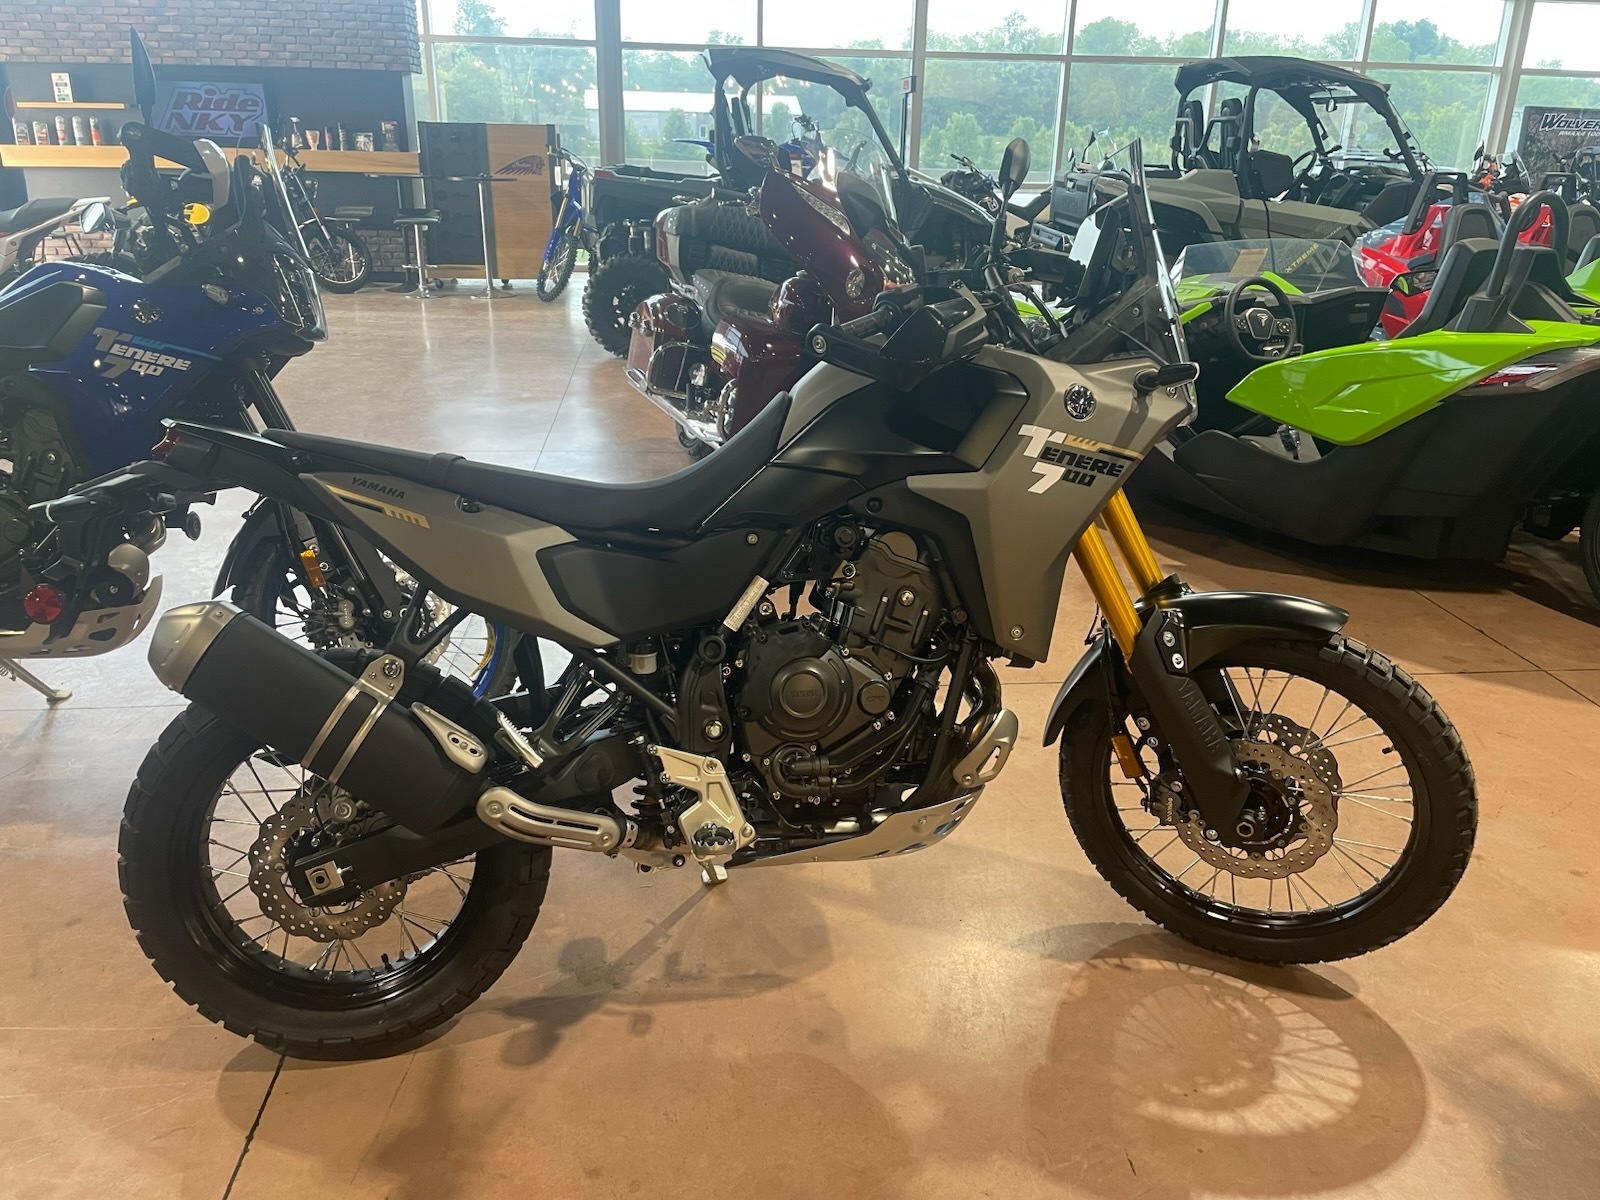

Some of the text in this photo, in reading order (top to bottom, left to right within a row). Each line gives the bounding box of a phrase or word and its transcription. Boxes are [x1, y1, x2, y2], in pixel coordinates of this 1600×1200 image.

[172, 88, 261, 113] Ride
[164, 112, 257, 133] NKY
[1285, 242, 1320, 273] XTREME
[101, 354, 164, 379] 700
[352, 477, 405, 499] YAMAHA
[1027, 461, 1097, 494] 700
